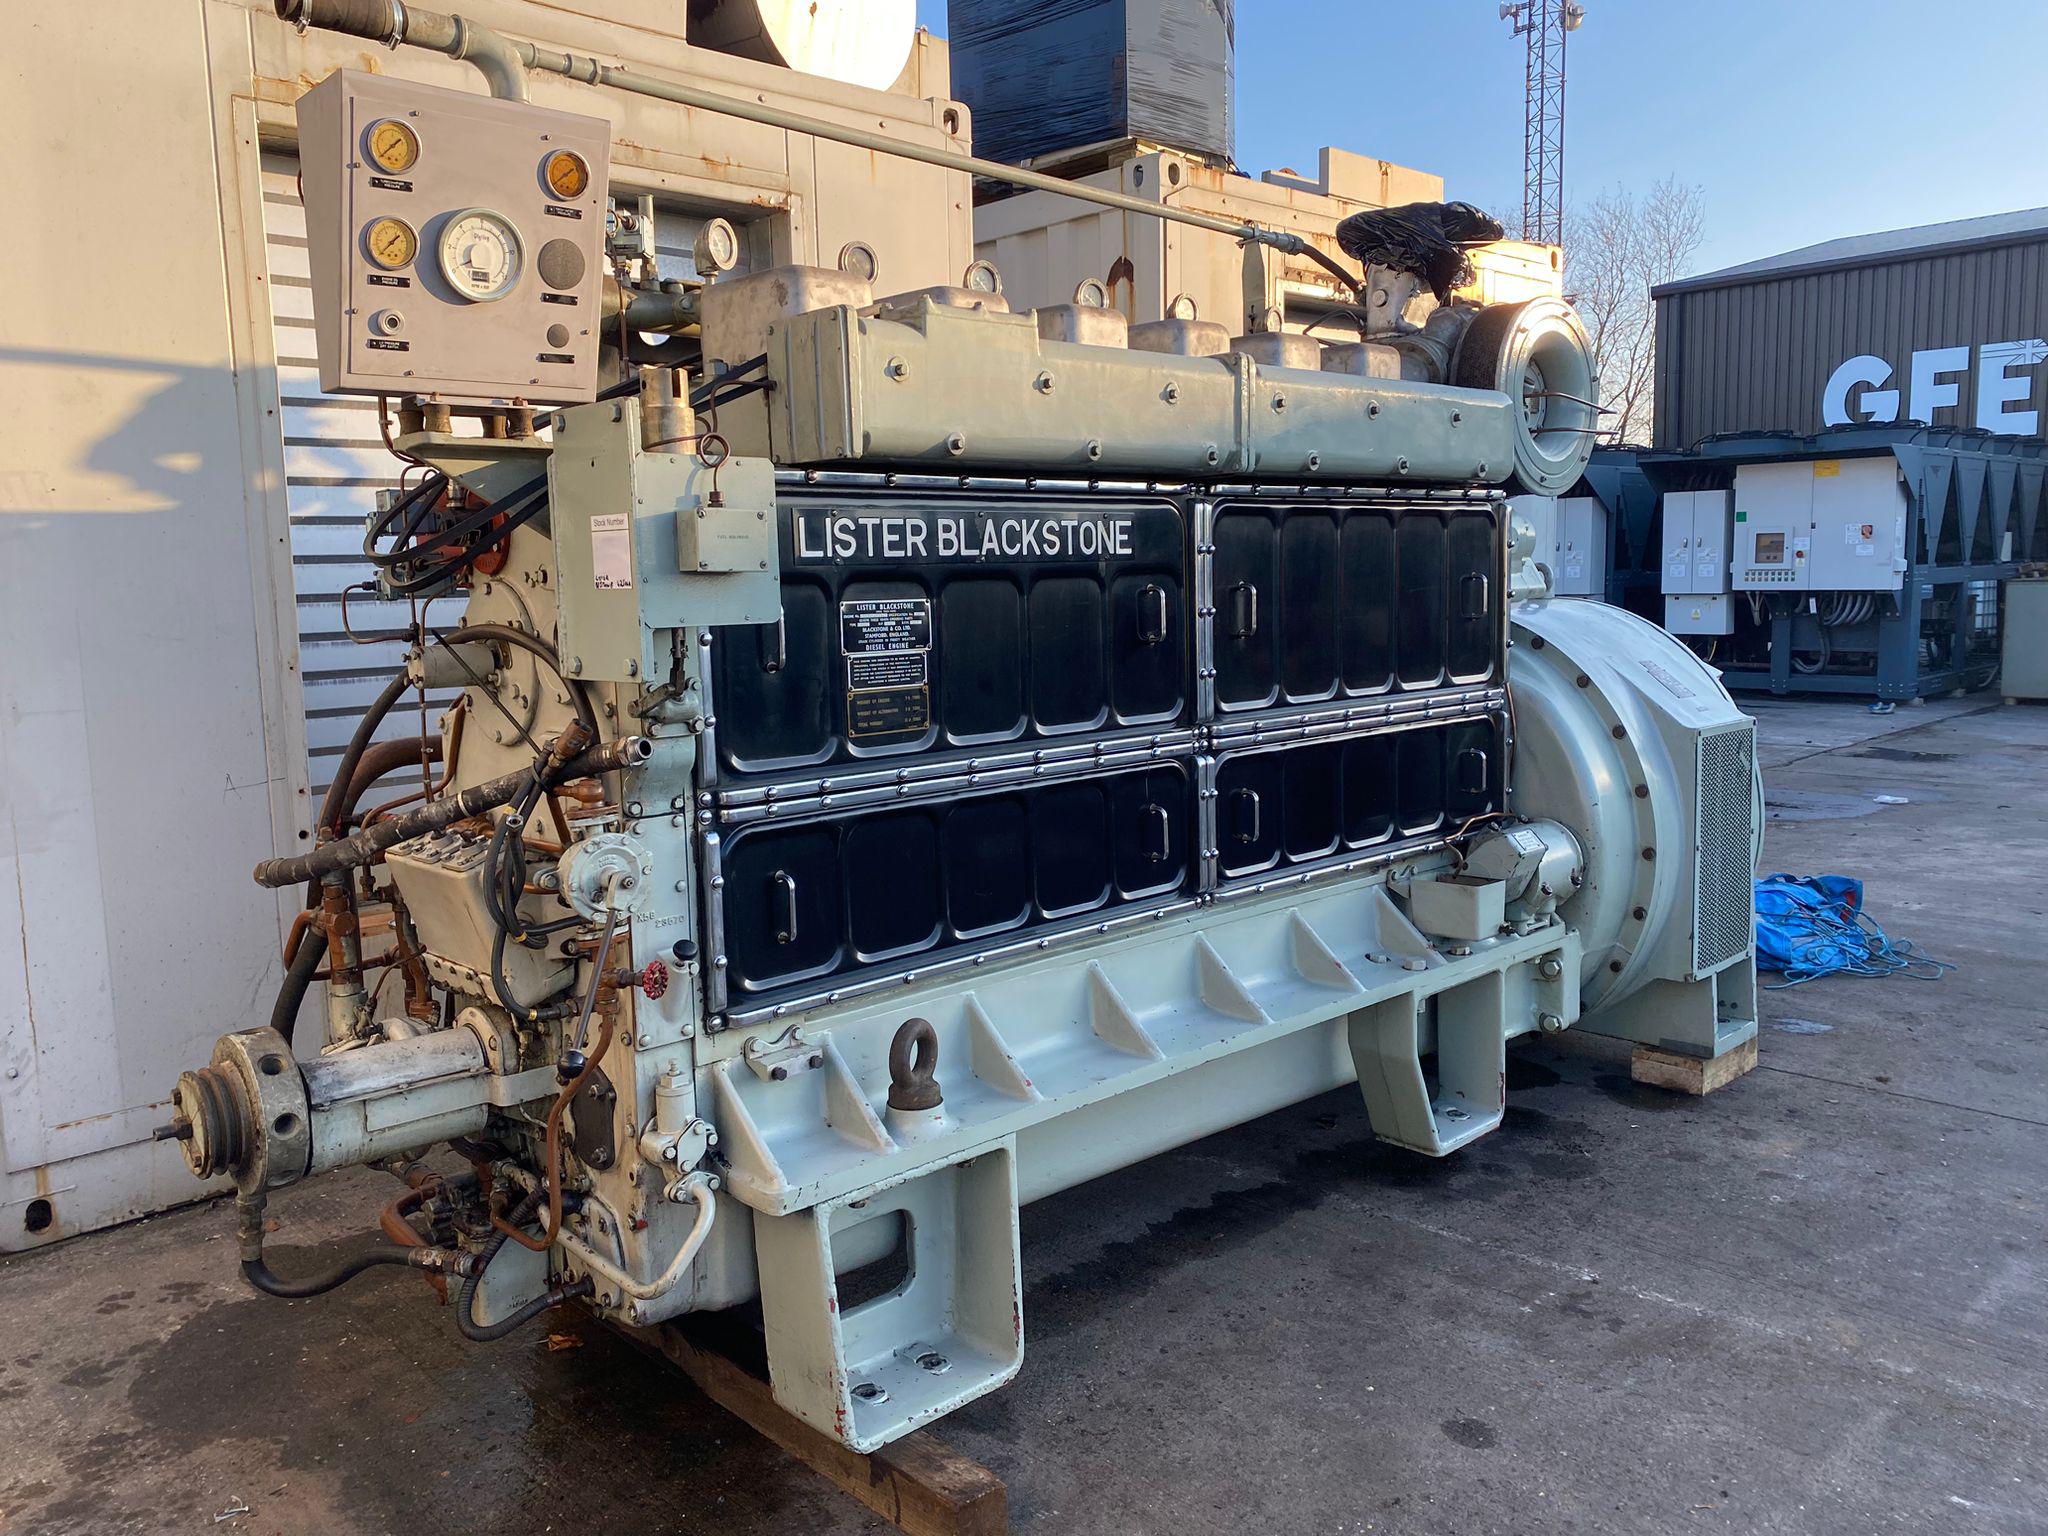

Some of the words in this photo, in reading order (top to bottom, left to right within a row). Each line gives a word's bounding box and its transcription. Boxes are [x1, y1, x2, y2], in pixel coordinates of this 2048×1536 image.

[1823, 338, 2048, 436] GFE
[606, 518, 624, 526] Number
[798, 516, 928, 558] LISTER
[937, 518, 1133, 557] BLACKSTONE
[856, 603, 876, 611] LISTER
[880, 602, 915, 610] BLACKSTONE
